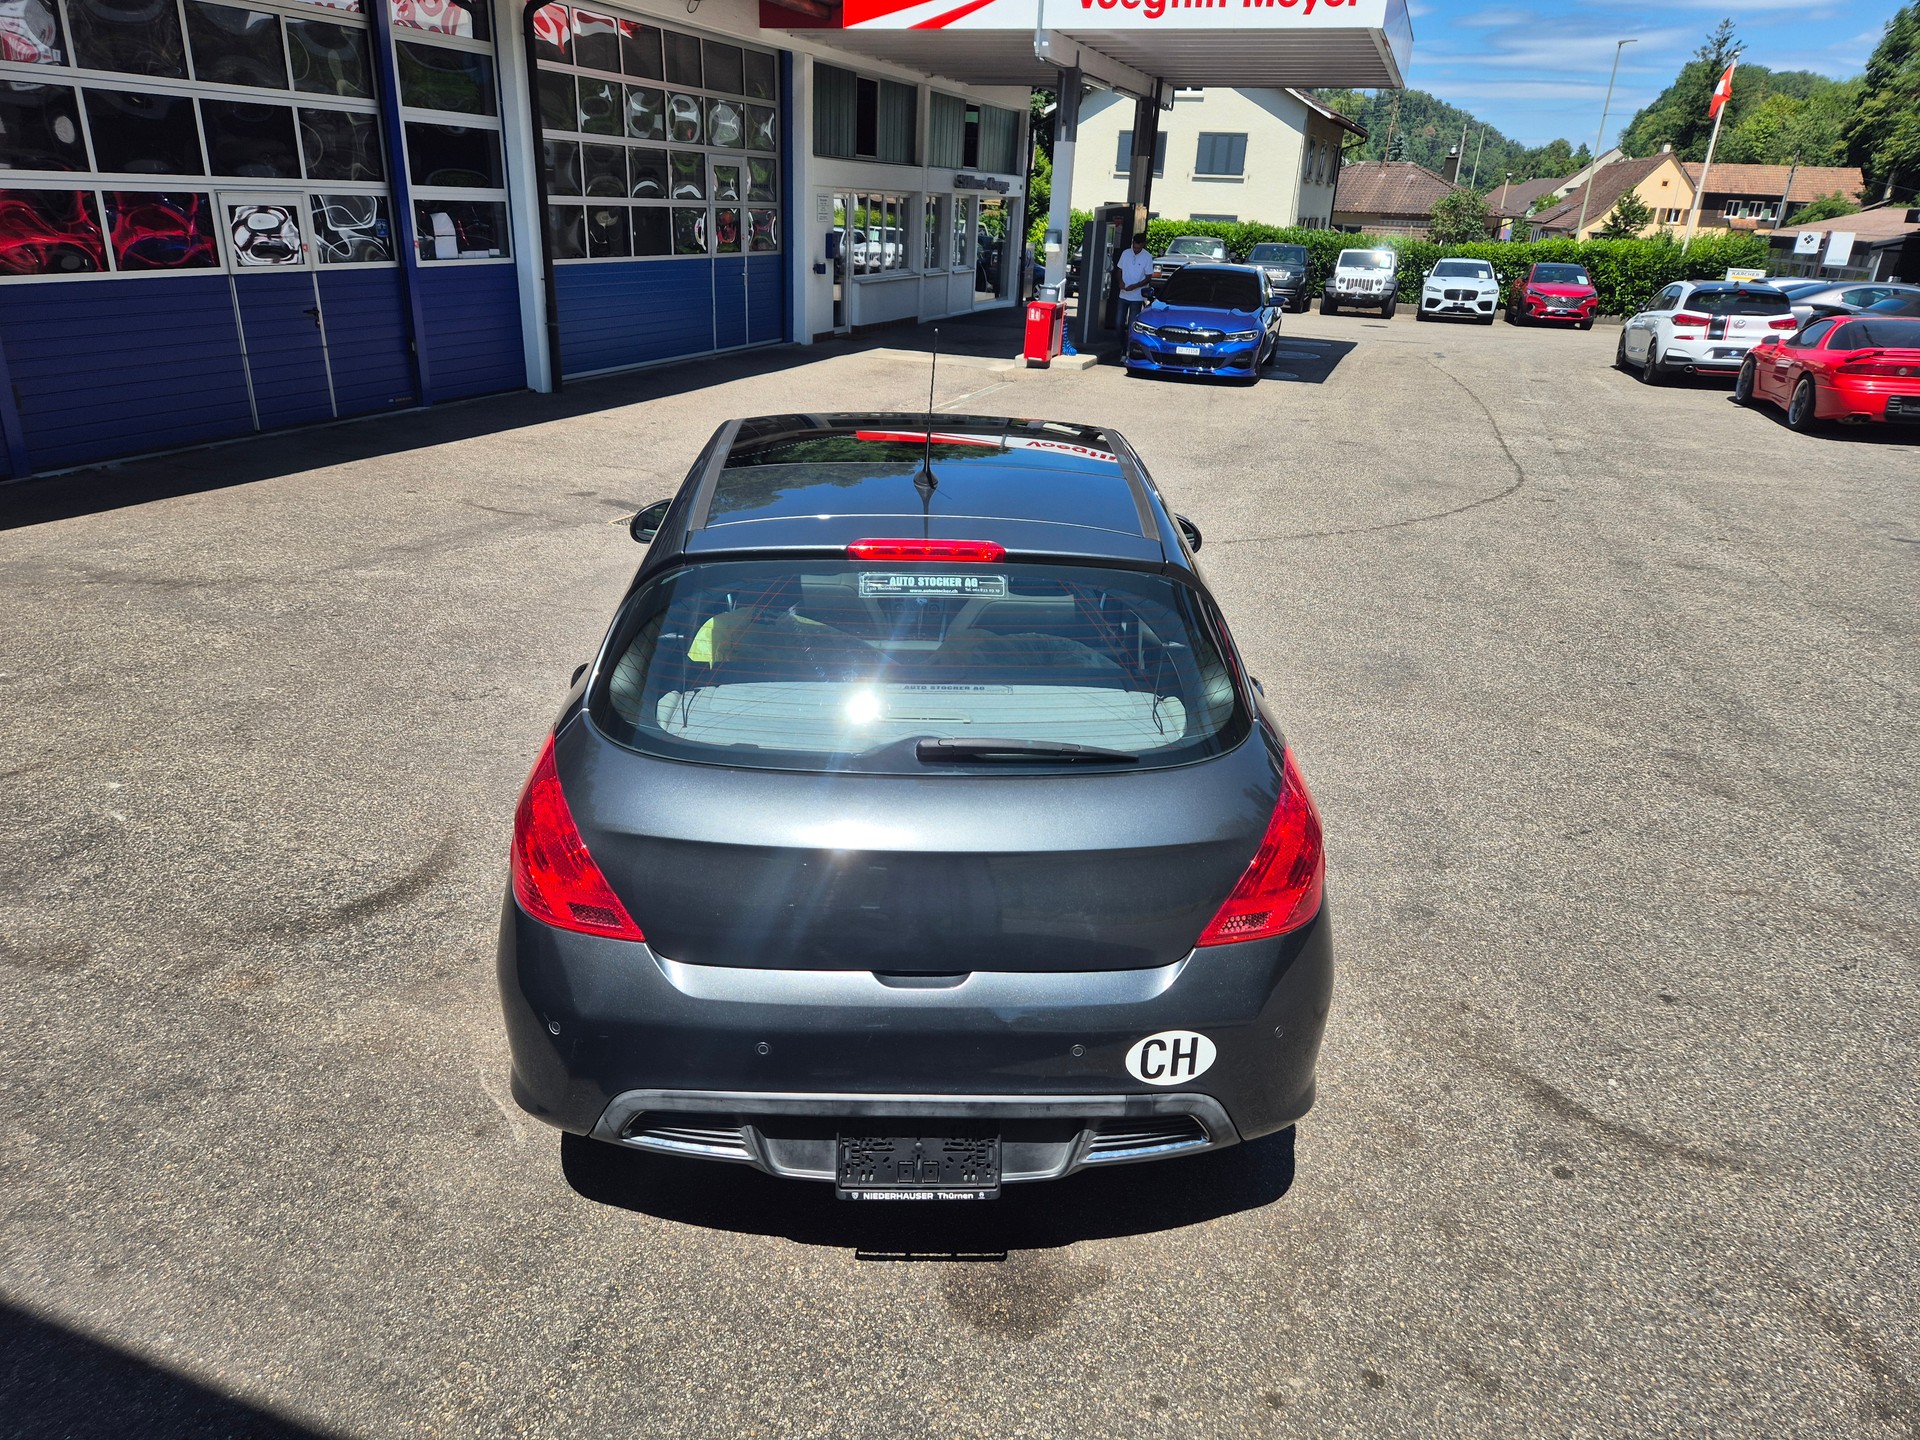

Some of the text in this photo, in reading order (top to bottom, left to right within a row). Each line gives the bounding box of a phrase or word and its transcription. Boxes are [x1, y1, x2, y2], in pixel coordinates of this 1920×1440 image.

[889, 576, 915, 586] AUTO
[917, 577, 962, 587] STOCKER
[964, 577, 978, 588] AG
[1141, 1036, 1199, 1080] CH
[863, 1192, 974, 1200] NIEDERHAUSER Thürnen
